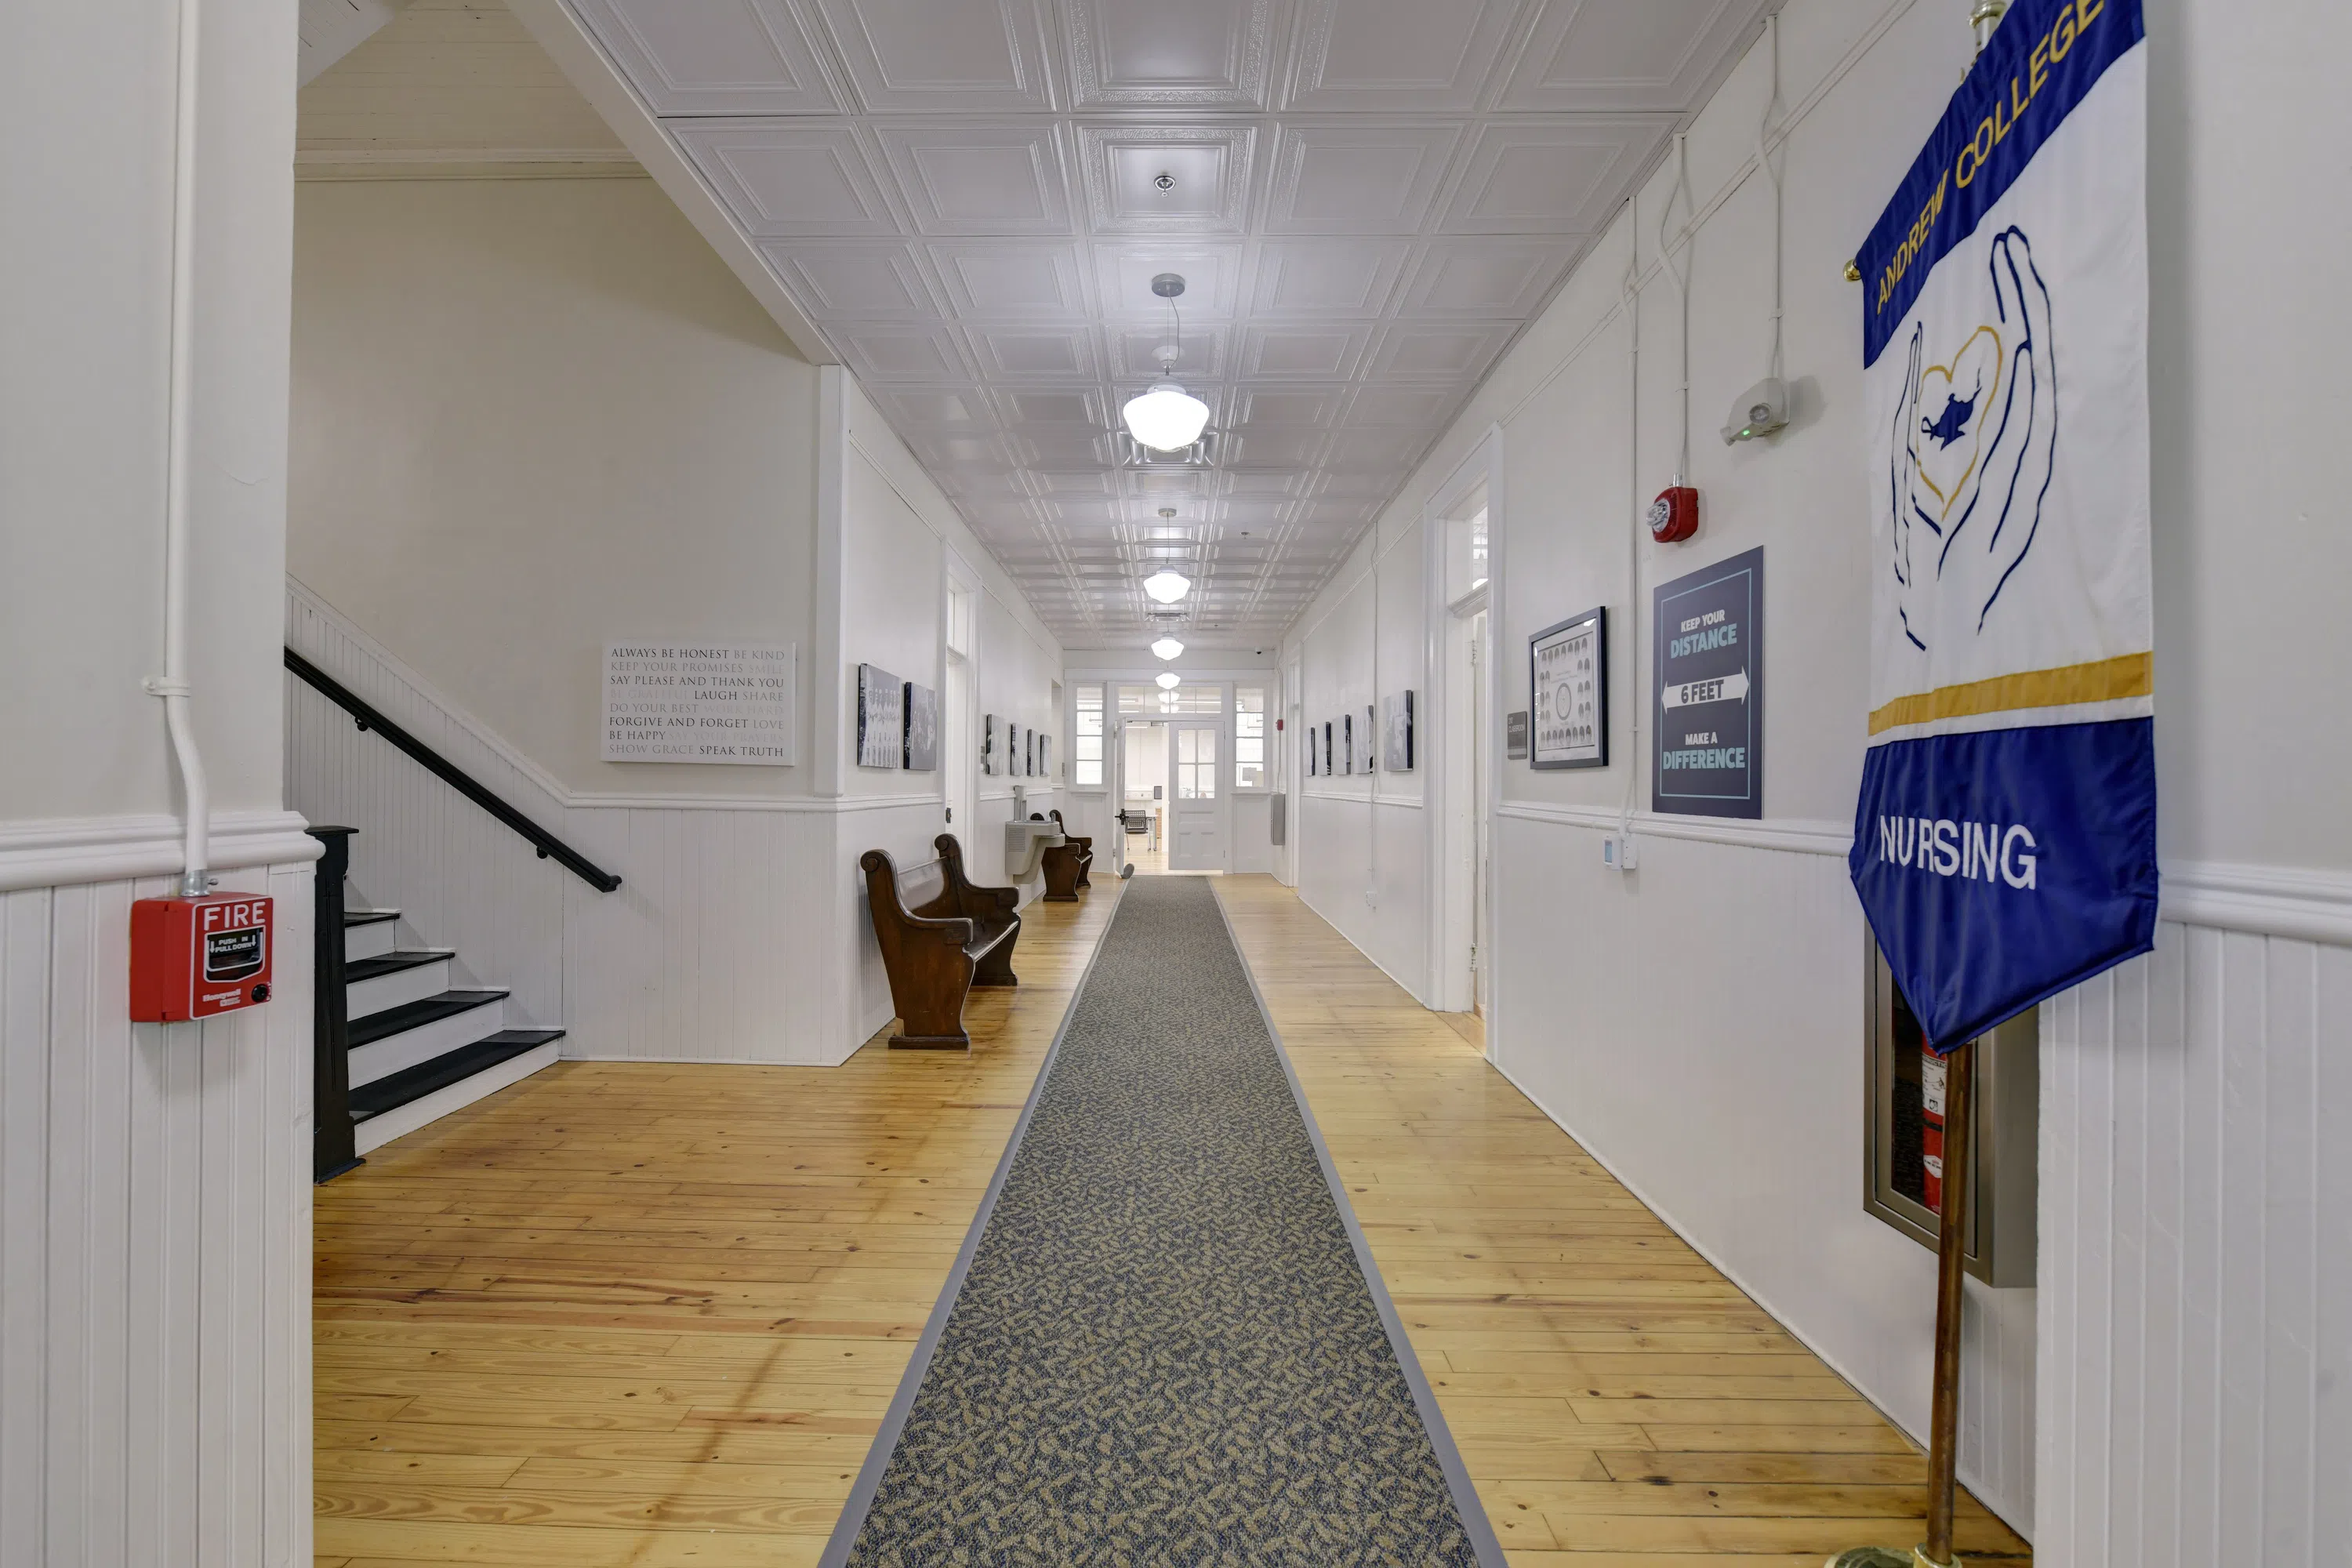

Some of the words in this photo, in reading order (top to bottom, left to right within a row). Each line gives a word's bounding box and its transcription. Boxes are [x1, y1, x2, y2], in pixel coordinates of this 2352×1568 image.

[1877, 168, 1948, 315] ANDREW
[1955, 0, 2105, 189] COLLEGE
[1681, 616, 1700, 633] KEEP
[1701, 609, 1725, 628] YOUR
[1671, 623, 1737, 659] DISTANCE
[612, 648, 656, 658] ALWAYS
[662, 648, 674, 658] BE
[680, 649, 729, 659] HONEST
[734, 650, 746, 659] BE
[753, 651, 785, 660] KIND
[611, 662, 639, 671] KEEP
[644, 662, 677, 671] YOUR
[683, 662, 743, 673] PROMISES
[750, 665, 784, 674] SMILE
[611, 675, 630, 684] SAY
[635, 676, 674, 685] PLEASE
[679, 677, 706, 686] AND
[711, 677, 754, 687] THANK
[759, 678, 784, 688] YOU
[695, 690, 737, 700] LAUGH
[742, 691, 784, 701] SHARE
[1681, 685, 1689, 704] 6
[1691, 679, 1724, 702] FEET
[610, 703, 628, 712] DO
[633, 703, 666, 713] YOUR
[672, 704, 699, 713] BEST
[705, 705, 743, 714] WORK
[747, 706, 784, 715] HARD
[609, 717, 662, 726] FORGIVE
[667, 717, 695, 727] AND
[700, 718, 748, 728] FORGET
[753, 720, 784, 729] LOVE
[609, 731, 622, 739] BE
[627, 731, 666, 740] HAPPY
[669, 731, 688, 740] SAY
[694, 731, 728, 741] YOUR
[1686, 732, 1709, 746] MAKE
[1711, 731, 1718, 744] A
[609, 744, 648, 753] SHOW
[652, 745, 694, 754] GRACE
[699, 746, 736, 755] SPEAK
[740, 746, 783, 757] TRUTH
[1663, 747, 1745, 770] DIFFERENCE
[1880, 815, 2037, 891] NURSING
[204, 902, 266, 931] FIRE
[233, 942, 251, 950] DOWN
